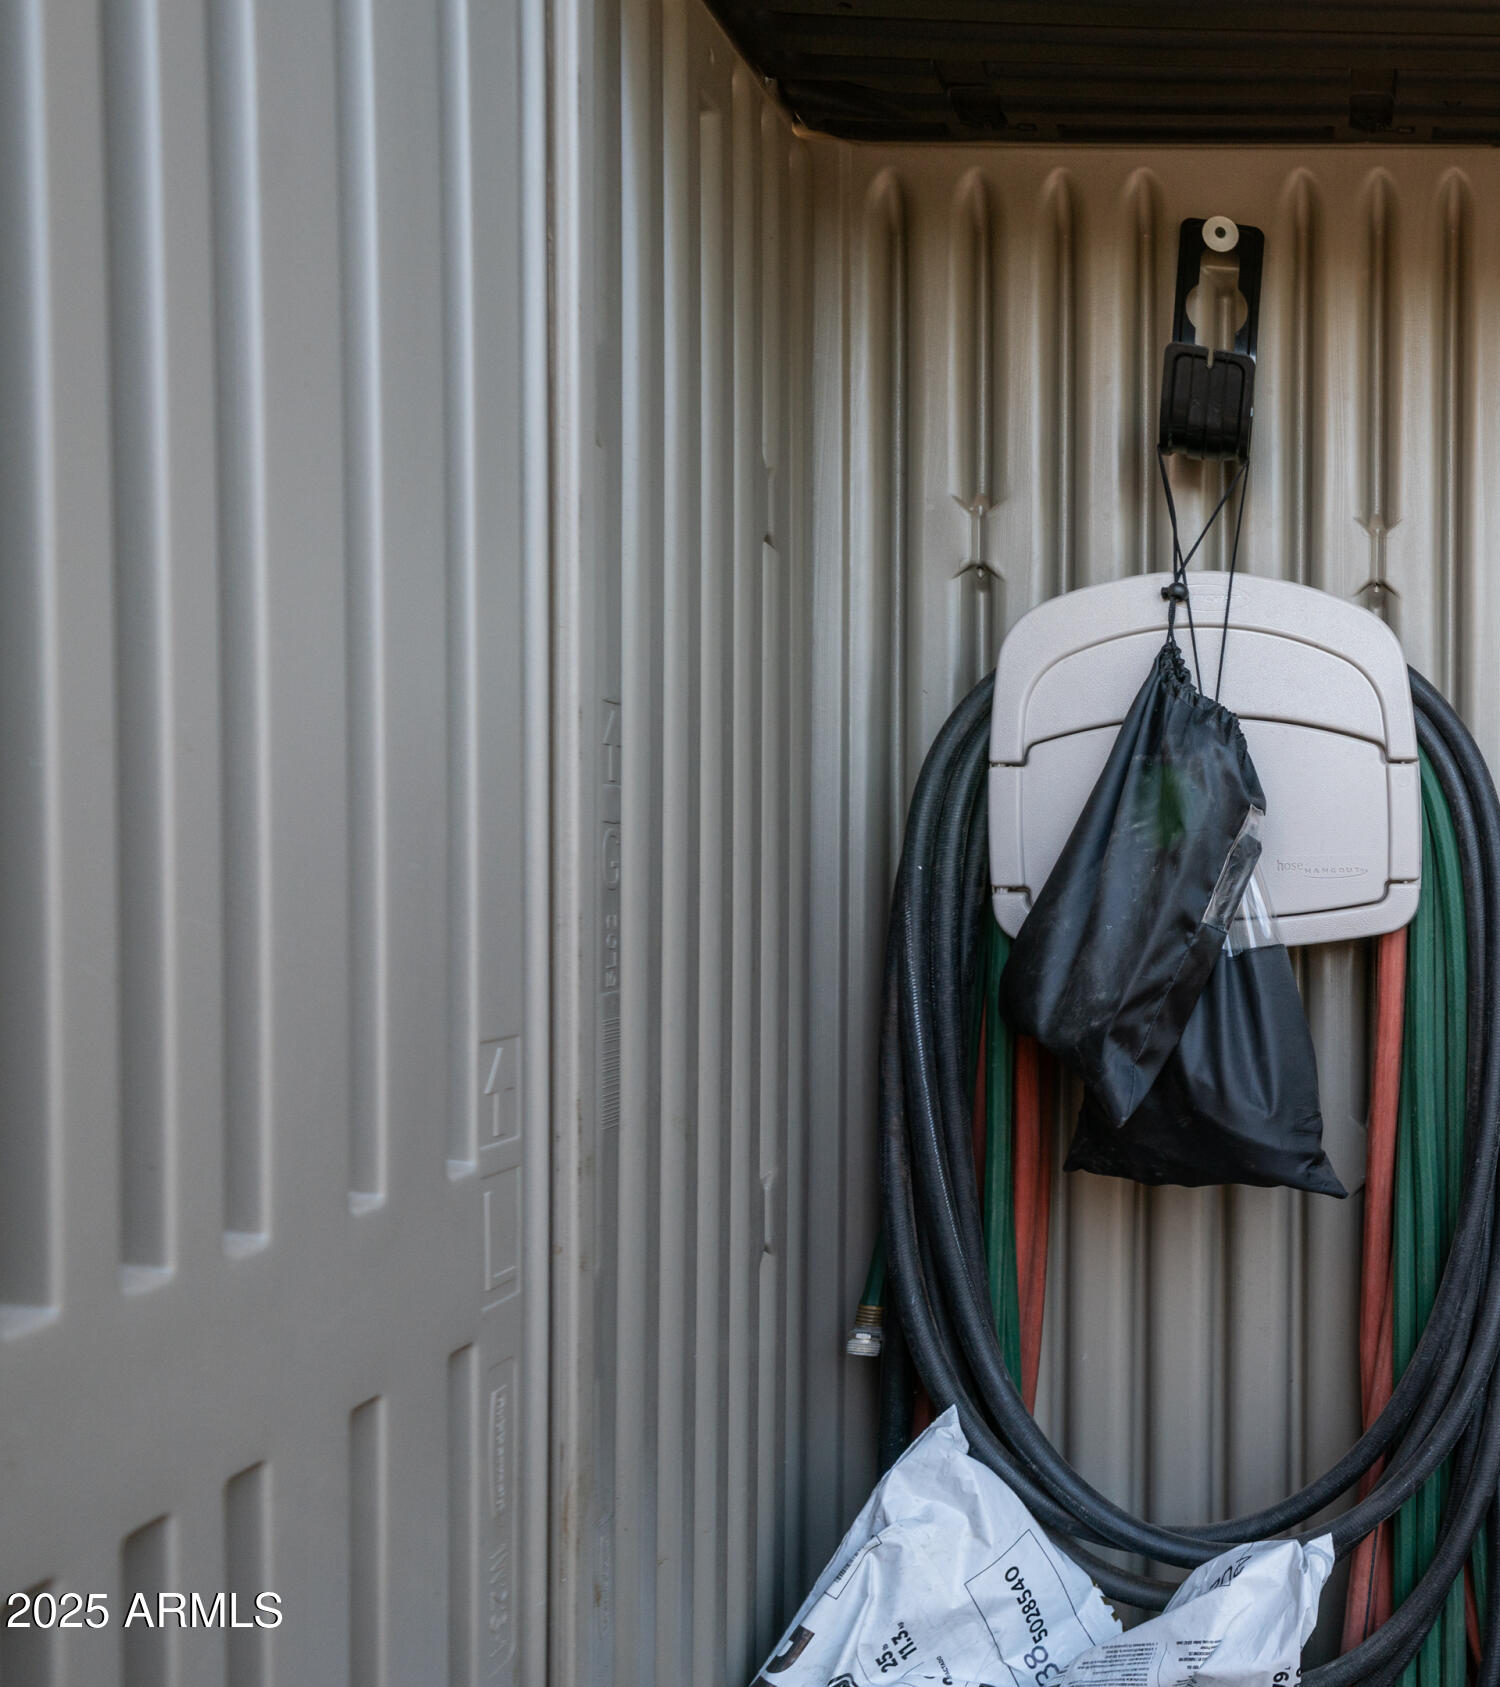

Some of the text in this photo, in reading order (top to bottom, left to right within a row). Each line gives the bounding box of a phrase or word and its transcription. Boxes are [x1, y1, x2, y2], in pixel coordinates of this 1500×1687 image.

[1275, 858, 1303, 872] hose
[1004, 1565, 1049, 1645] 5028540
[891, 1629, 917, 1661] 11.3
[875, 1651, 898, 1673] 25
